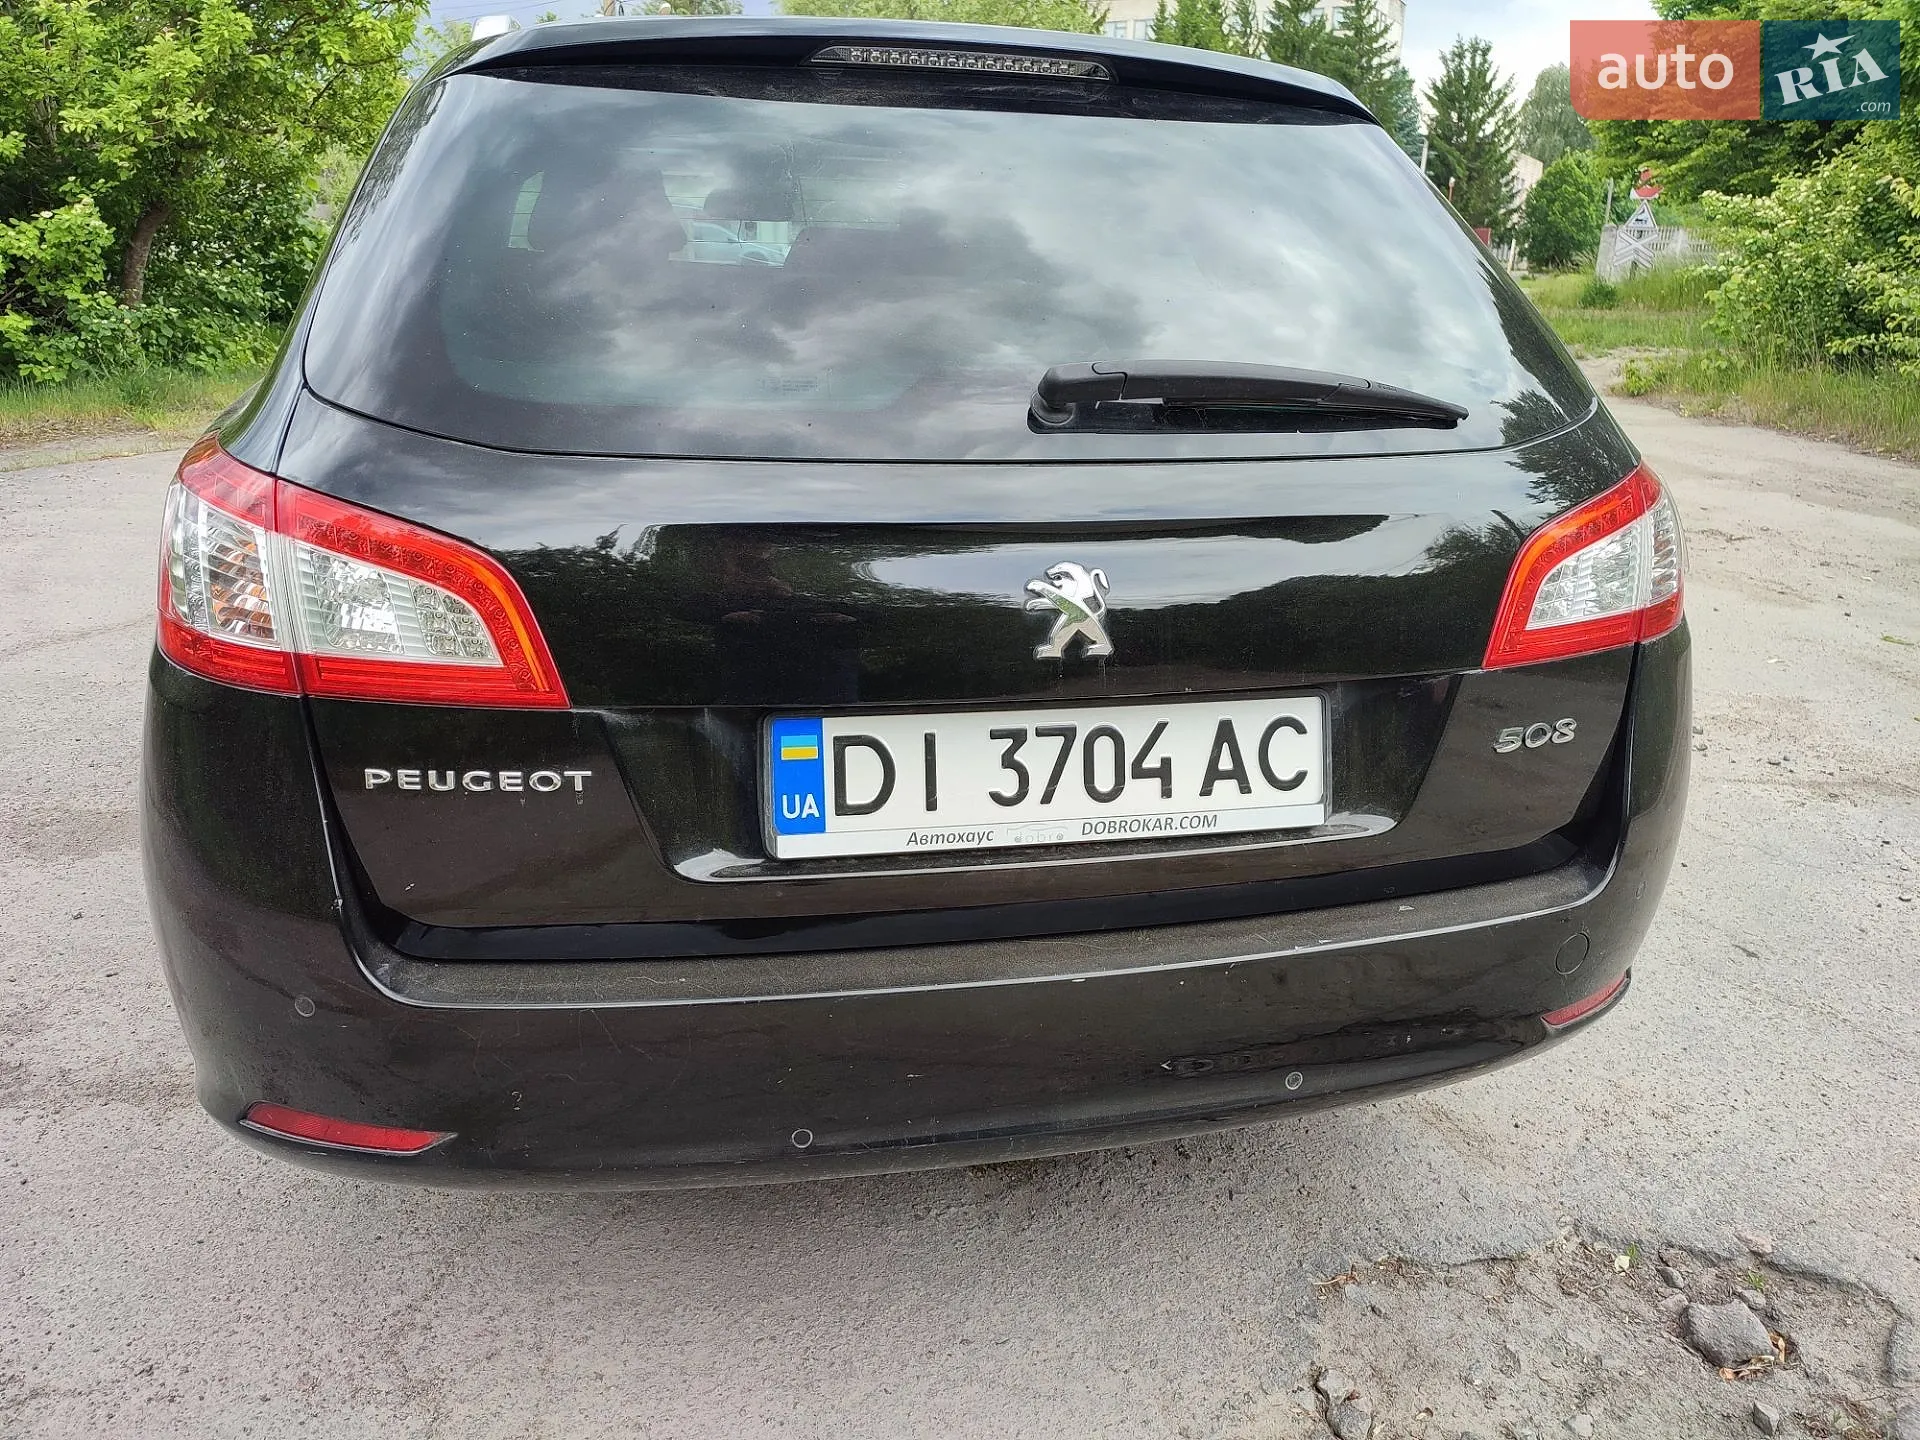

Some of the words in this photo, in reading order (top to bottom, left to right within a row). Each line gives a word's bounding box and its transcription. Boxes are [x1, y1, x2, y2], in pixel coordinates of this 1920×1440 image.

[1494, 717, 1577, 753] 508
[832, 731, 938, 817] DI
[987, 716, 1174, 808] 3704
[1198, 716, 1309, 797] AC
[364, 768, 593, 792] PEUGEOT
[782, 794, 820, 819] UA
[1081, 813, 1218, 836] DOBROKAR.COM
[906, 827, 995, 847] Автохаус
